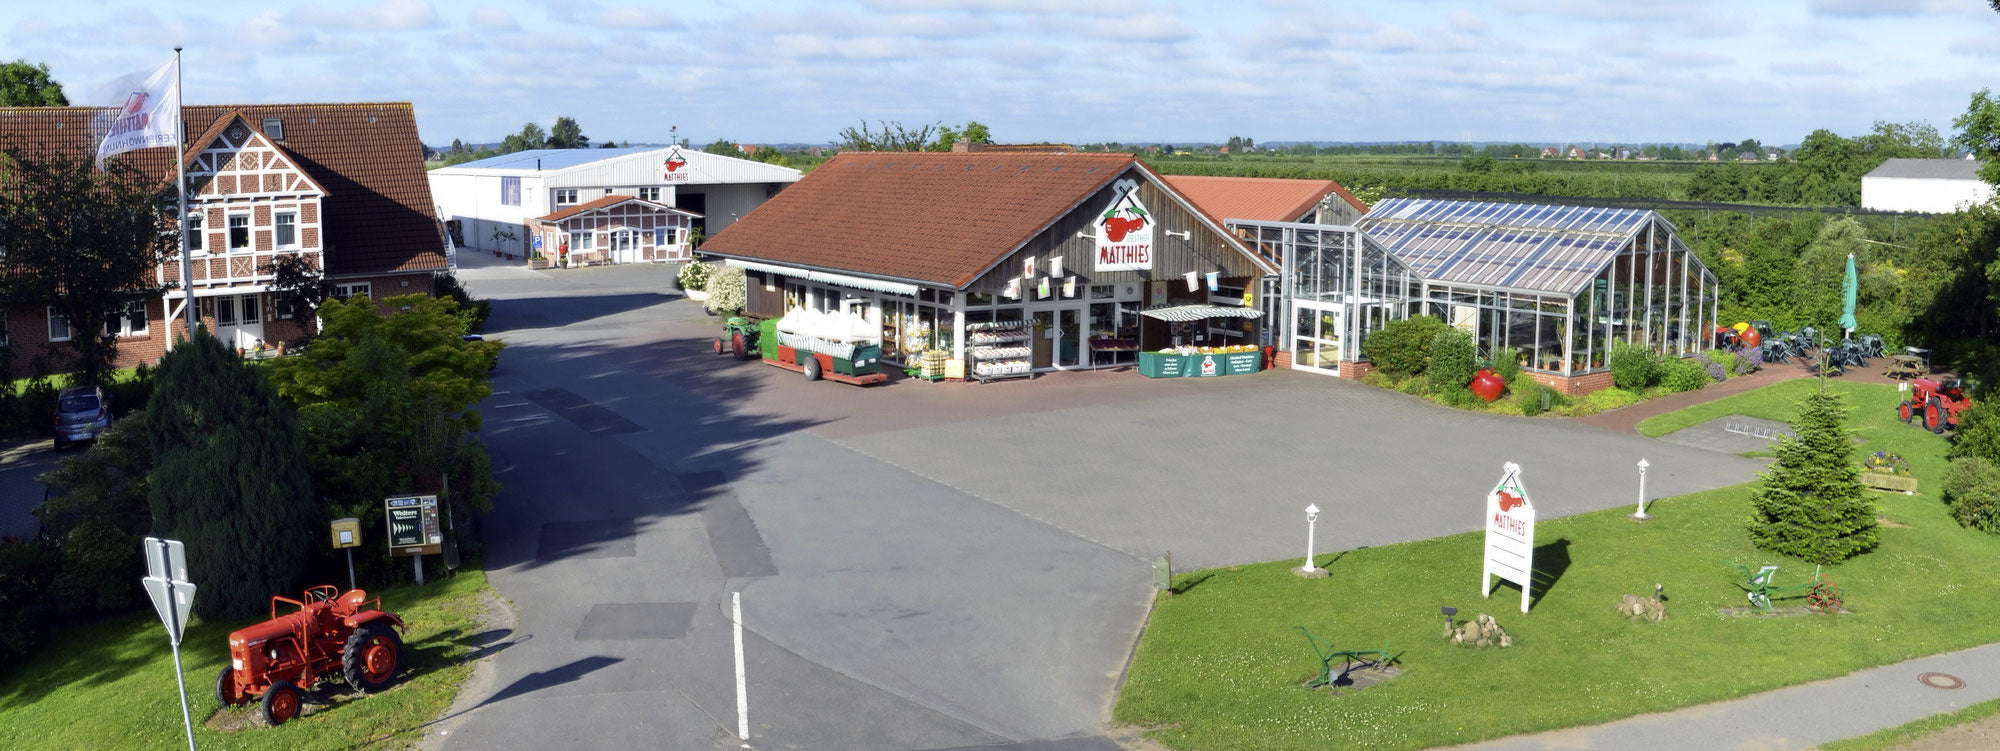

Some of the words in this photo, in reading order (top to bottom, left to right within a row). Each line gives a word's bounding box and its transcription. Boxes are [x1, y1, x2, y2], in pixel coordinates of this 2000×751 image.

[664, 173, 688, 181] MATTHIES
[535, 236, 541, 244] P
[1100, 245, 1149, 264] MATTHIES
[1494, 512, 1525, 536] MATTHIES
